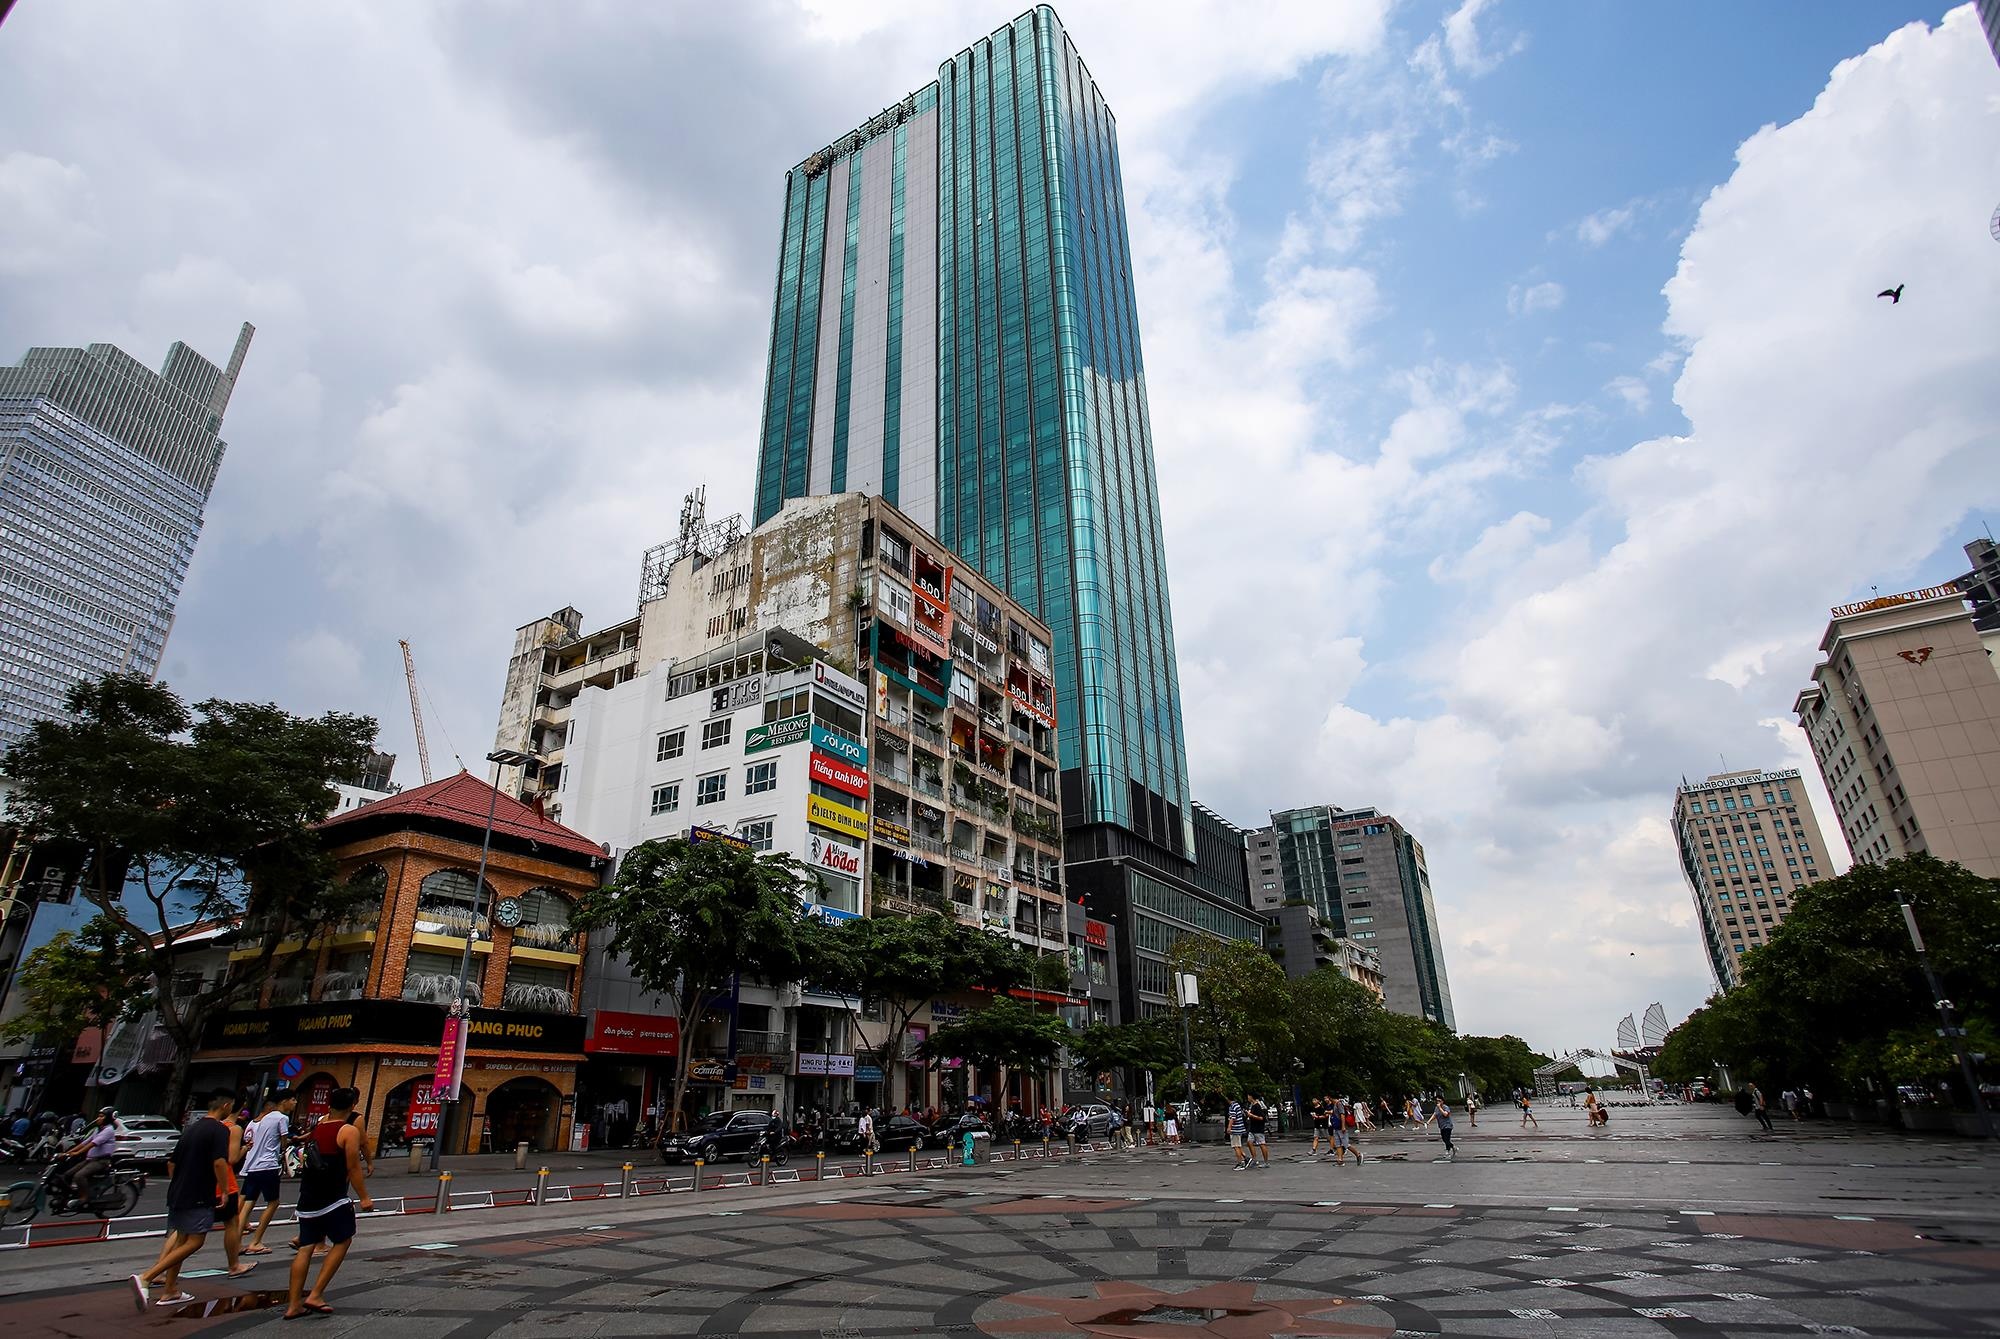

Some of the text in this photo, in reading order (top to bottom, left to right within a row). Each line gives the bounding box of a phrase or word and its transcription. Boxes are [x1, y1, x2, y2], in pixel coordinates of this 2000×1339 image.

[920, 577, 940, 599] BOO
[1831, 600, 1875, 617] SAIGON
[959, 621, 974, 639] THE
[974, 631, 998, 655] LETTER
[730, 677, 760, 699] TTG
[1010, 683, 1027, 701] BOO
[731, 692, 760, 706] HOLDING
[1035, 699, 1051, 716] BOO
[767, 717, 809, 737] MEKONG
[771, 731, 804, 746] REST STOP
[839, 742, 860, 758] spa
[812, 759, 833, 780] Tiếng
[834, 770, 849, 784] anh
[1692, 769, 1799, 792] HARBOUR VIEW TOWER
[820, 807, 837, 821] IELTS
[853, 819, 868, 832] LONG
[1086, 935, 1106, 947] PLAZA
[223, 1021, 269, 1036] HOANG PHUC
[298, 1014, 353, 1031] HOANG PHUC
[467, 1021, 544, 1038] OANG PHUC
[393, 1058, 428, 1067] Martens
[823, 1059, 836, 1067] TNG
[411, 1112, 440, 1130] 50%
